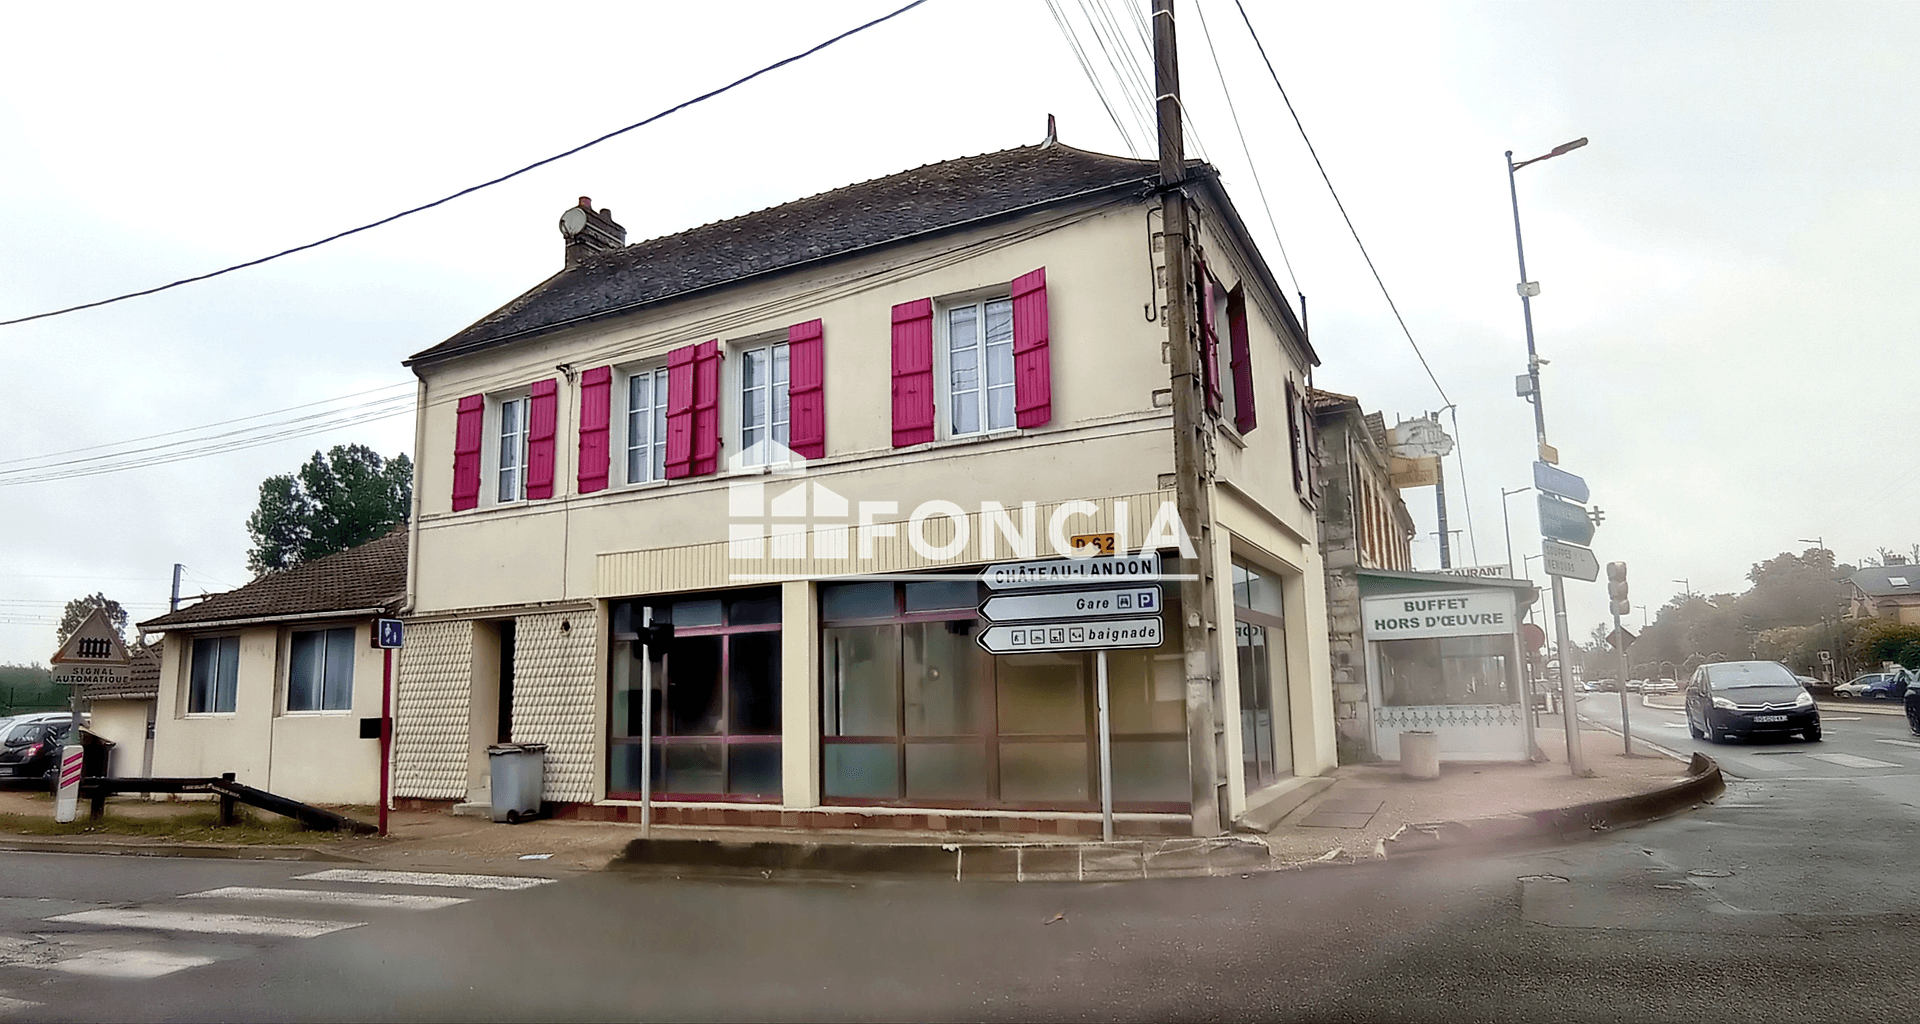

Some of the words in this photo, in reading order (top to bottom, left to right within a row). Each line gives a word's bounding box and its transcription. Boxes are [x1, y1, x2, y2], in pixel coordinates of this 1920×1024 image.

[1076, 539, 1085, 552] D
[994, 560, 1152, 584] CHÂTEAU-LANDON
[1076, 598, 1109, 610] Gare
[1404, 597, 1469, 612] BUFFET
[1375, 616, 1420, 630] HORS
[1425, 612, 1503, 628] D'ŒUVRE
[1089, 626, 1155, 642] baignade
[72, 667, 114, 675] SIGNAL
[56, 675, 129, 683] AUTOMATIQUE
